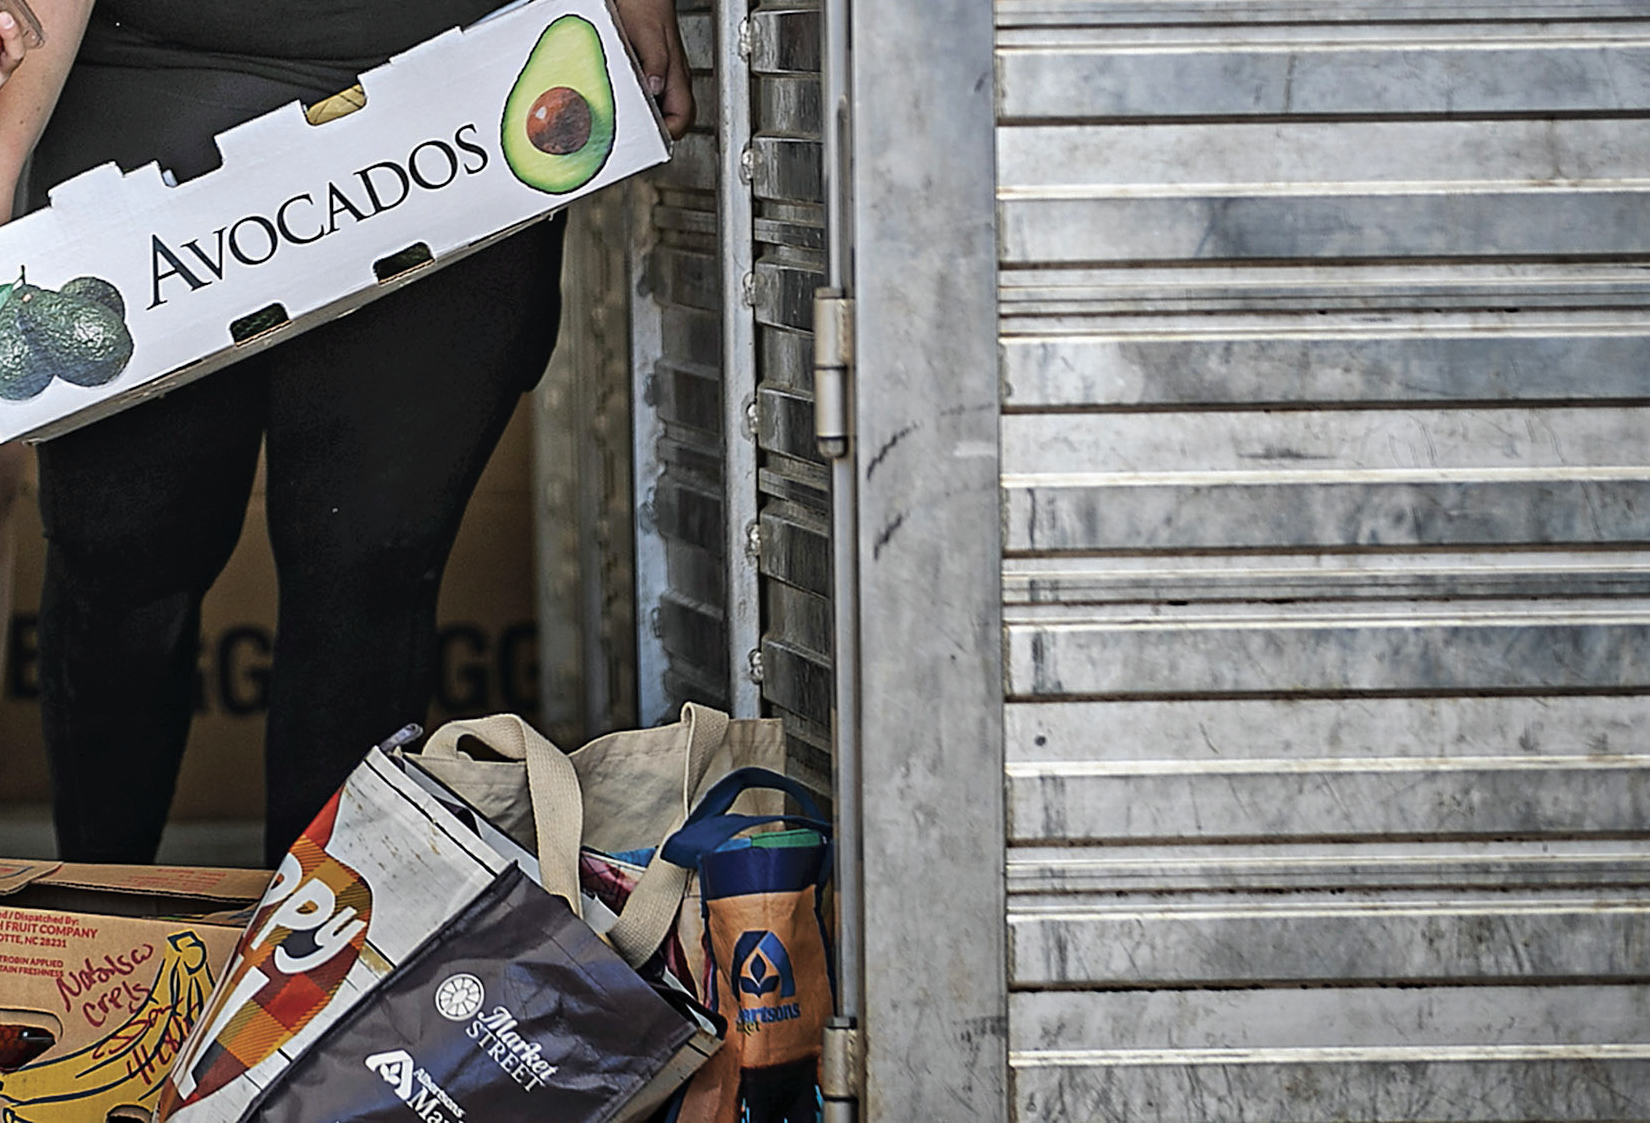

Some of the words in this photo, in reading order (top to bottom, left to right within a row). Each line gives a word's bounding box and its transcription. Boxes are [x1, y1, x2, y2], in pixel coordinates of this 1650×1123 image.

[146, 123, 489, 310] AVOCADOS
[14, 911, 64, 924] Dispatched
[5, 921, 38, 933] FRUIT
[39, 924, 98, 939] COMPANY
[24, 936, 39, 946] NC
[40, 937, 67, 948] 28231
[30, 958, 64, 968] APPLIED
[18, 967, 64, 978] FRESHNESS
[477, 1005, 559, 1081] Market
[465, 1020, 547, 1093] STREET
